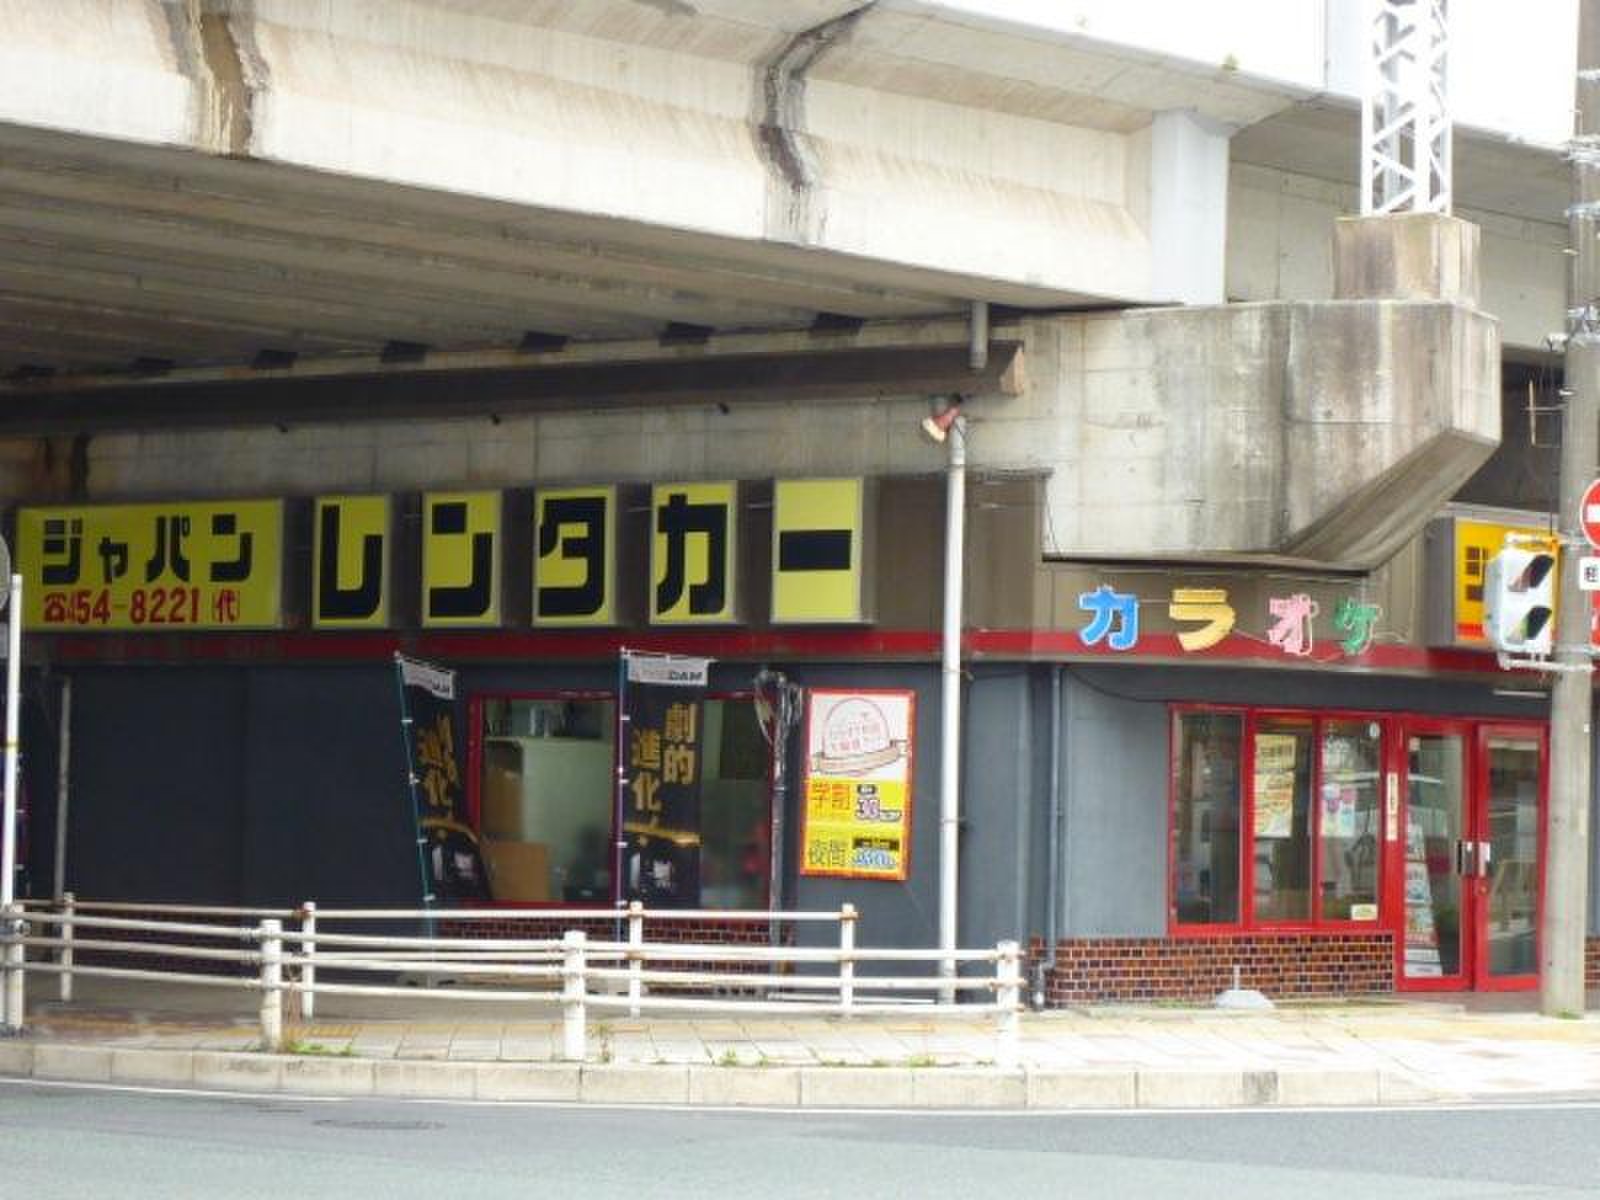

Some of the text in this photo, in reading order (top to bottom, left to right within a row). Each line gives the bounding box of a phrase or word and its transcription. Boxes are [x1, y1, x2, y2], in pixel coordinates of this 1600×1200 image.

[42, 513, 254, 585] ジャパン
[319, 494, 853, 619] レンタカー
[1079, 583, 1382, 656] カラオケ
